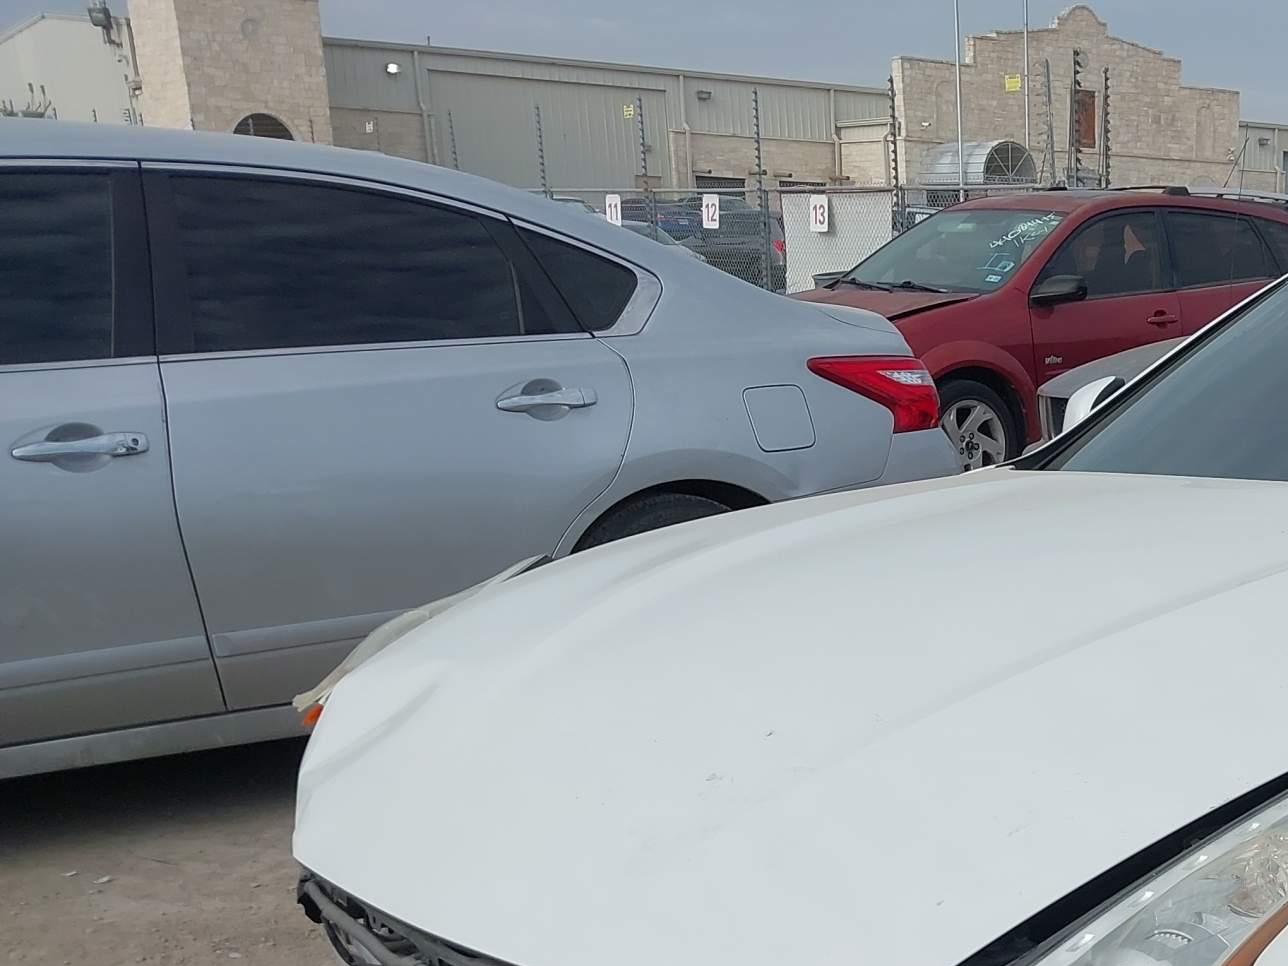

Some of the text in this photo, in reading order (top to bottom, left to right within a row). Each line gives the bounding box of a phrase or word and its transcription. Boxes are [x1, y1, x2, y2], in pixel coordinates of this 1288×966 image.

[608, 201, 619, 221] 11
[705, 203, 717, 222] 12
[812, 204, 825, 225] 13
